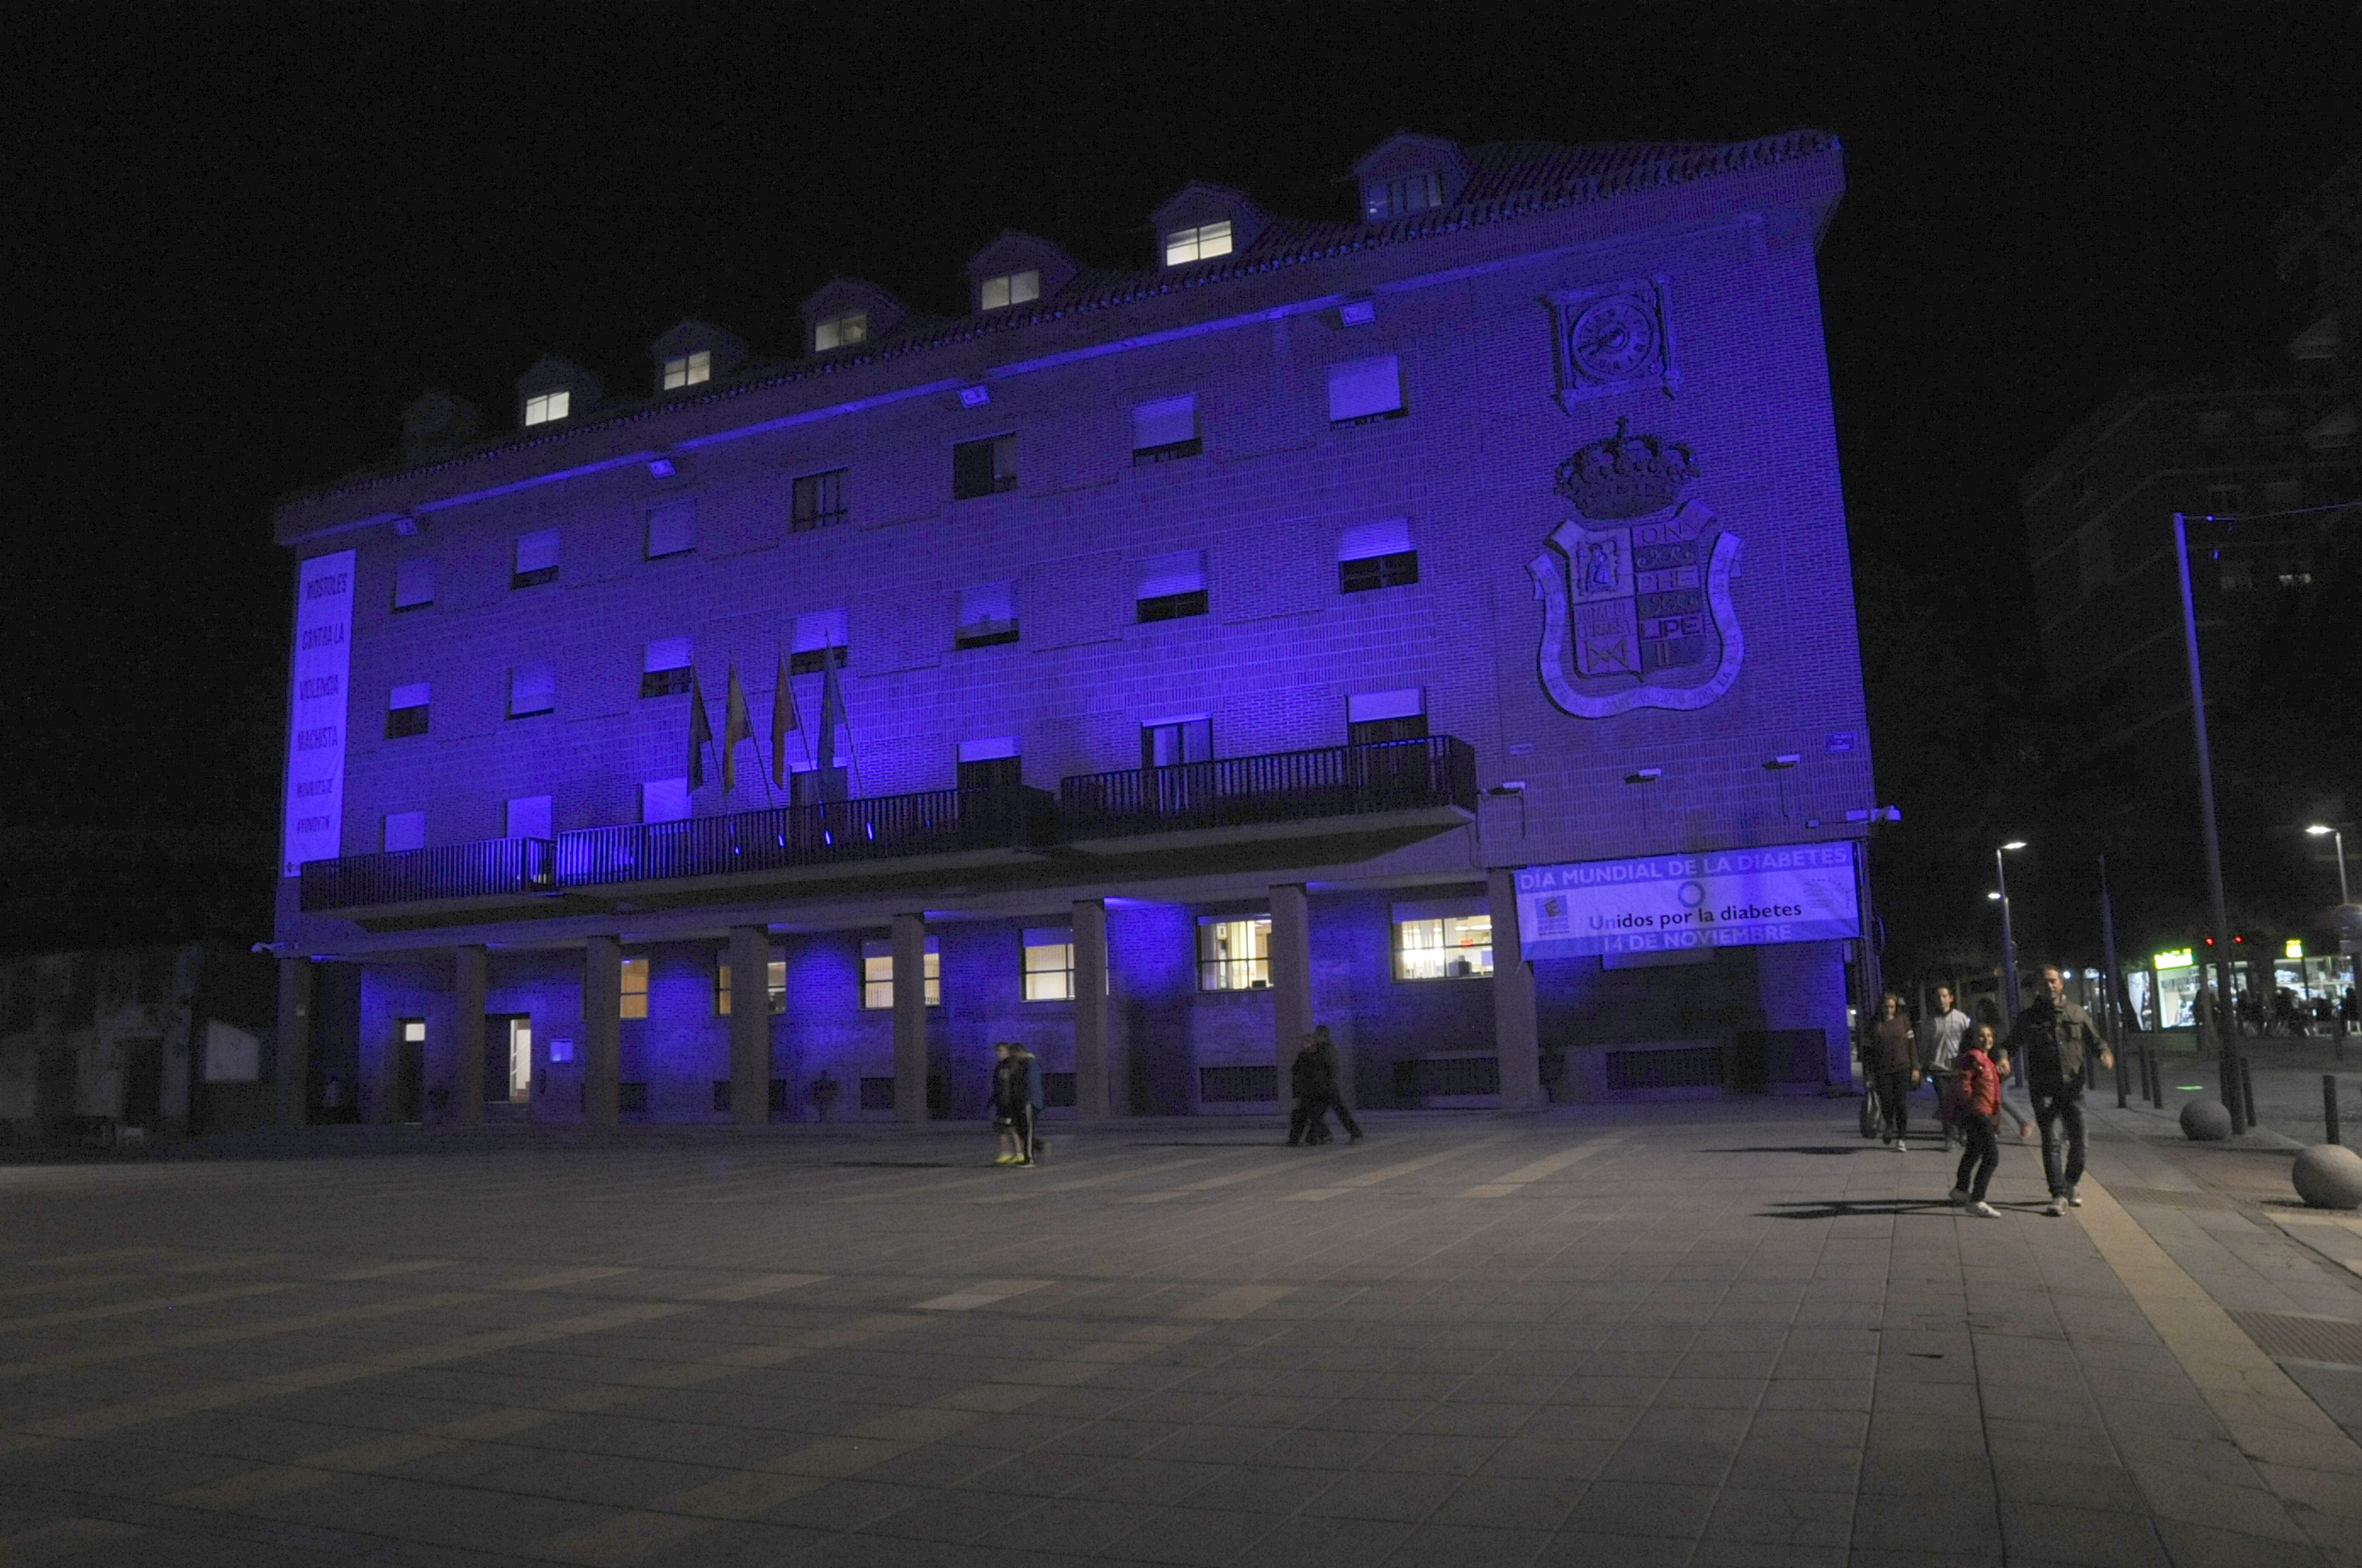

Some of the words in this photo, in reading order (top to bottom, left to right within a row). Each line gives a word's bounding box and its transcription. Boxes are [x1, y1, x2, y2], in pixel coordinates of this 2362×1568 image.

[1520, 868, 1557, 890] DÍA
[1562, 864, 1660, 887] MUNDIAL
[1668, 860, 1696, 876] DE
[1704, 856, 1731, 874] LA
[1738, 848, 1847, 871] DIABETES
[1589, 914, 1654, 931] Unidos
[1660, 910, 1693, 930] por
[1699, 907, 1715, 923] la
[1720, 902, 1803, 922] diabetes
[1604, 935, 1624, 952] 14
[1629, 933, 1658, 951] DE
[1665, 924, 1793, 949] NOVIEMBRE
